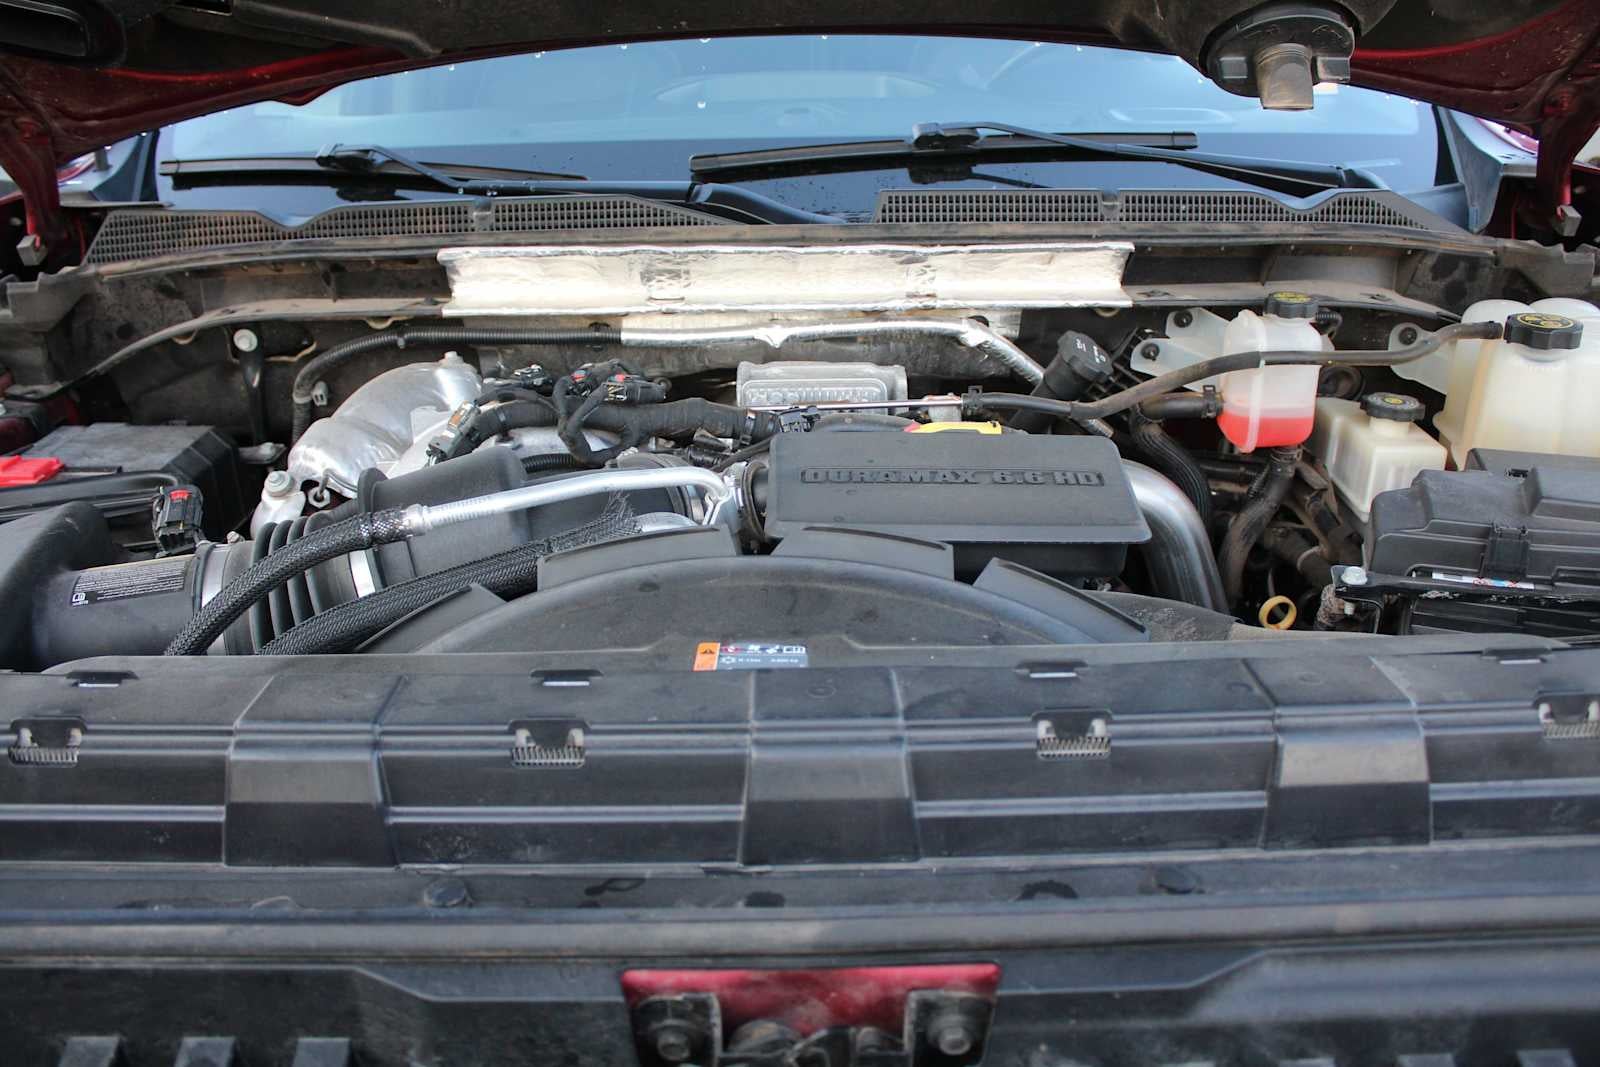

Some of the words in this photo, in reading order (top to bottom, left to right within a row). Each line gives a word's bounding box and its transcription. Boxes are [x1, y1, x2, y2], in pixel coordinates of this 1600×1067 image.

[802, 469, 979, 484] DURAMAX
[992, 470, 1046, 485] 6.6
[1052, 471, 1102, 487] HD
